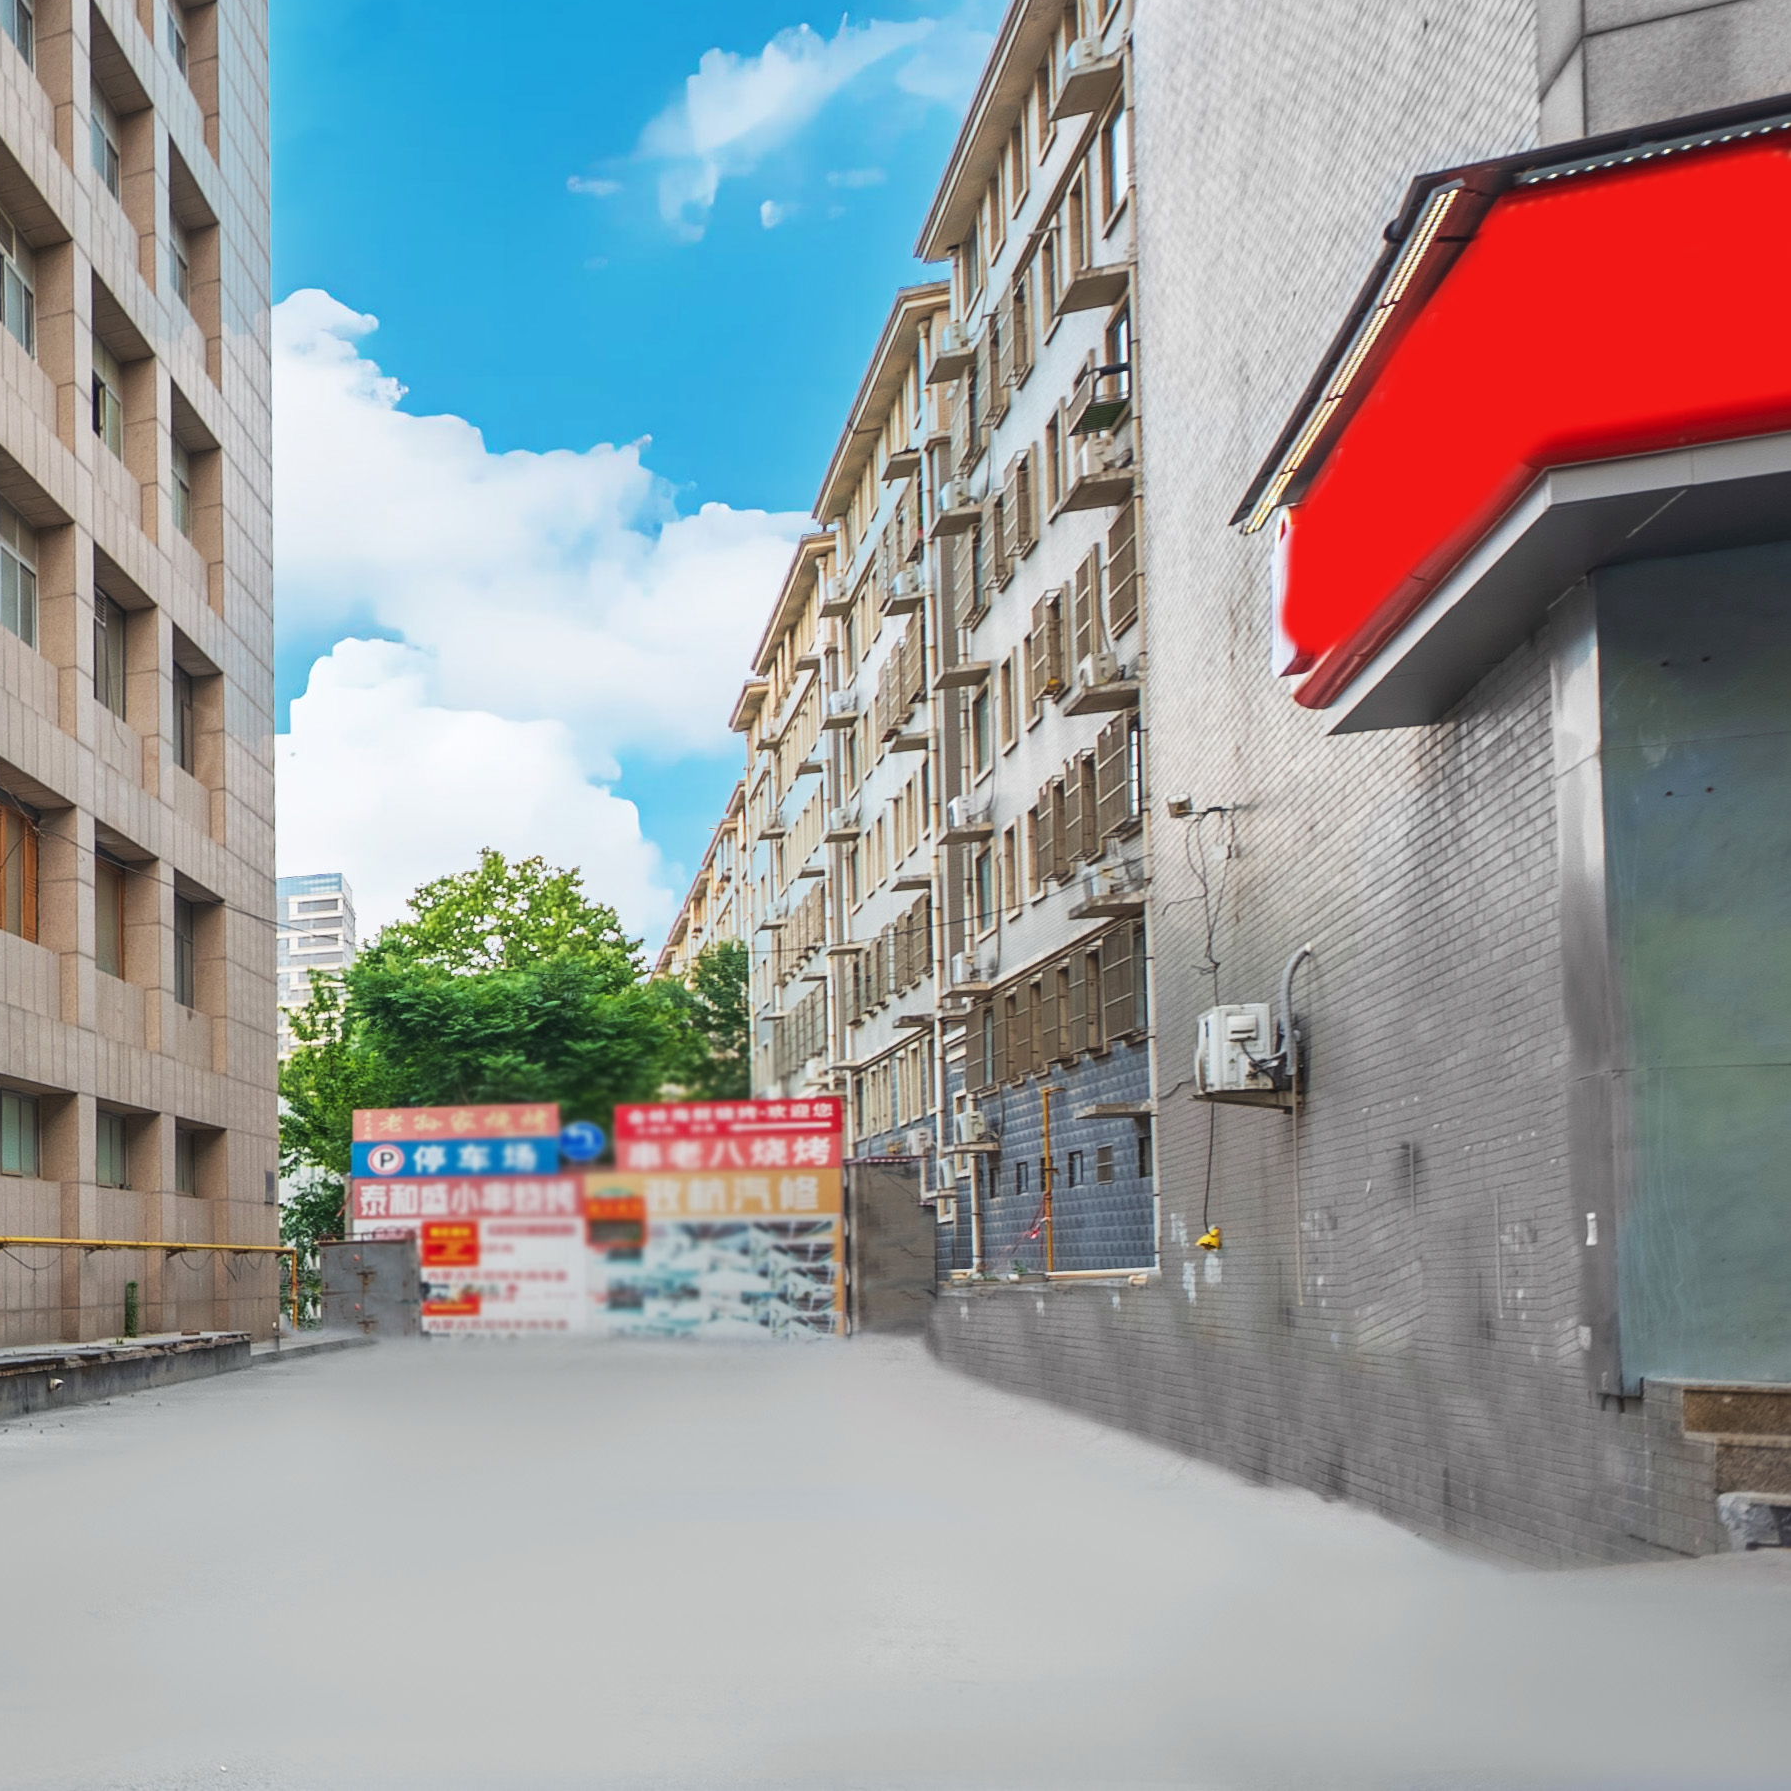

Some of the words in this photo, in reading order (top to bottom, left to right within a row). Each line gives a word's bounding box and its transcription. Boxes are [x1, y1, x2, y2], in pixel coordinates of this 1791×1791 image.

[380, 1152, 395, 1168] P
[413, 1143, 538, 1174] 停车场
